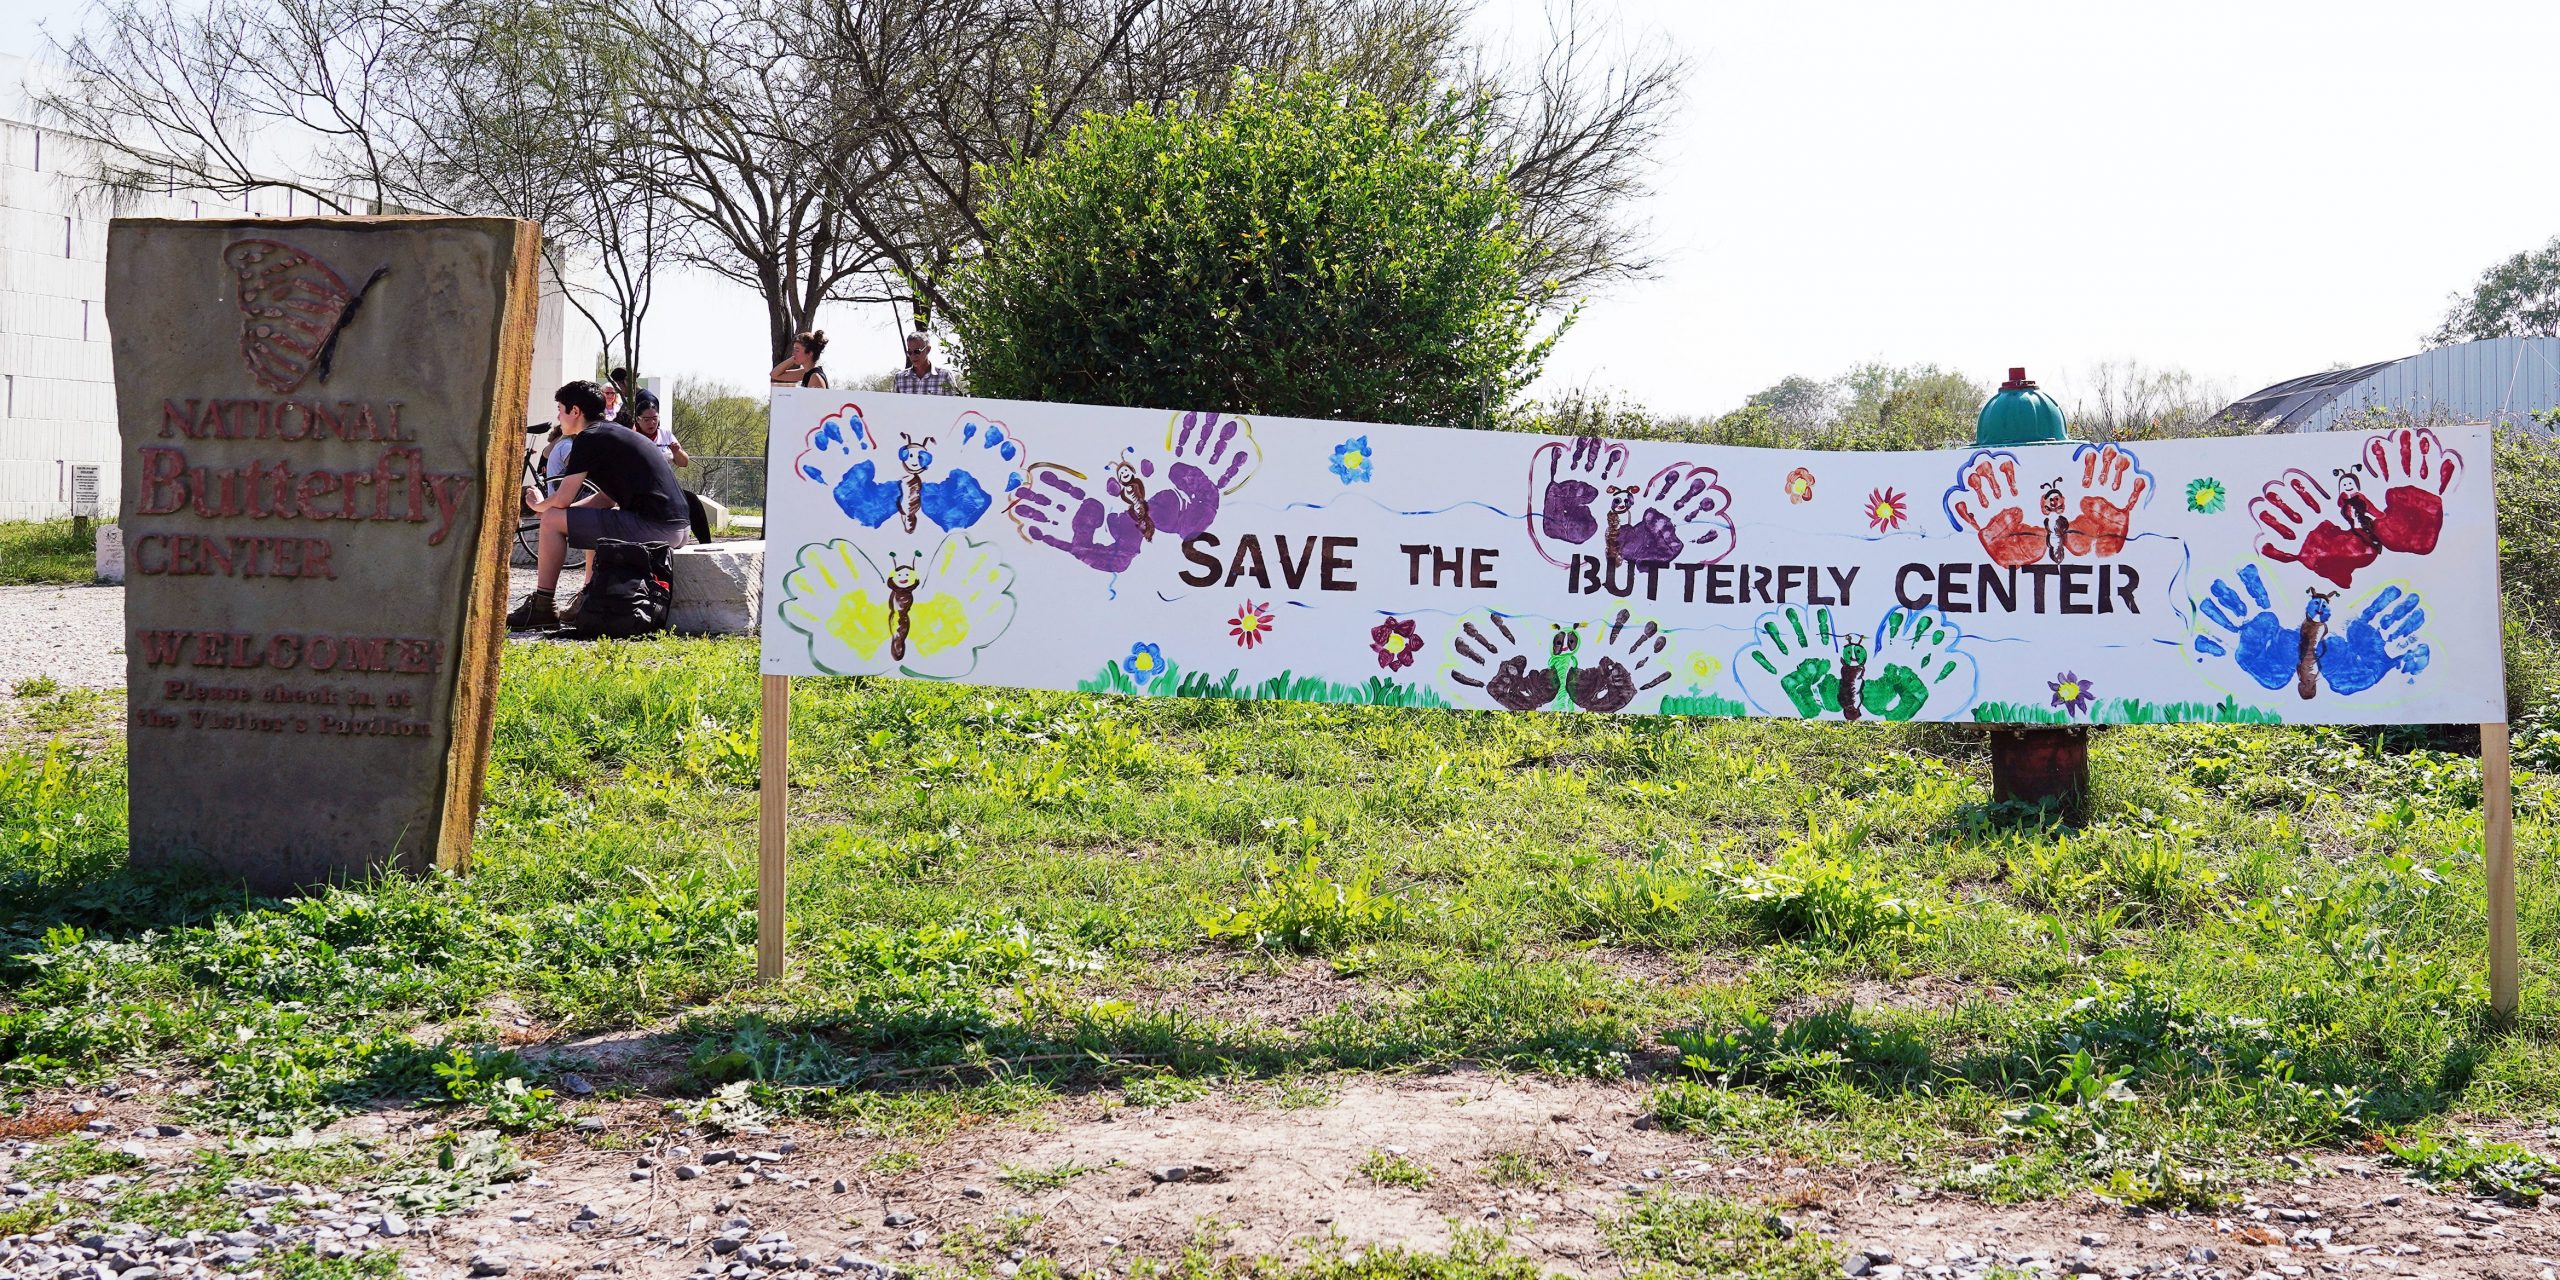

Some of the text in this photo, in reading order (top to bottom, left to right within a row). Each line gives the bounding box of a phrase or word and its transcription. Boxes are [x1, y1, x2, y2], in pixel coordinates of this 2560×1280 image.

[158, 399, 416, 442] NATIONAL
[132, 447, 472, 546] Butterfly
[131, 535, 337, 580] CENTER
[1178, 531, 2140, 614] SAVE THE BUTTERFLY CENTER
[138, 629, 445, 673] WELCOME!
[163, 680, 412, 708] Please check in at
[136, 708, 434, 738] the Visitor's Pavilion
